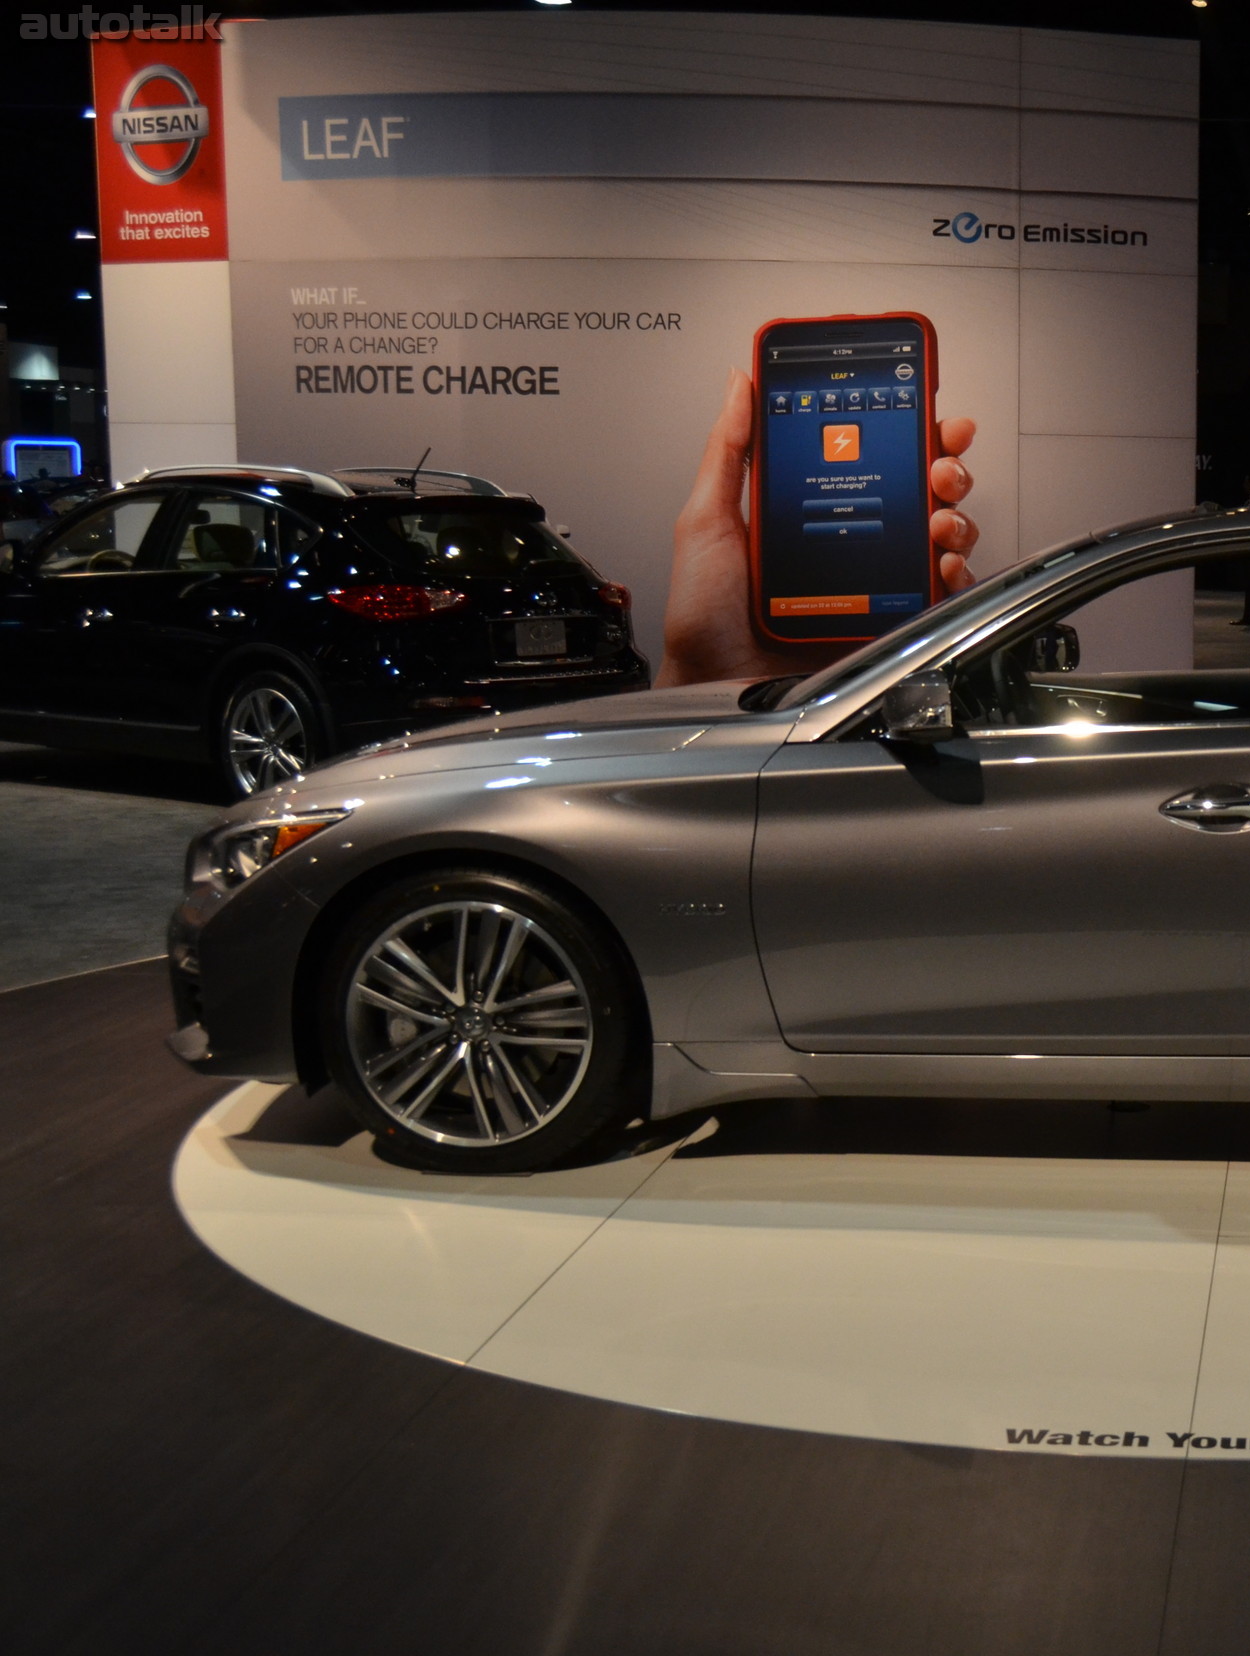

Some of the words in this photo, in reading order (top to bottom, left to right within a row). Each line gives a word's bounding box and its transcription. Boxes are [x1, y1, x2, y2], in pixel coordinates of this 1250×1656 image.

[122, 114, 200, 136] NISSAN
[302, 116, 405, 160] LEAF
[125, 209, 204, 226] Innovation
[119, 226, 151, 241] that
[153, 224, 211, 240] excites
[1023, 223, 1148, 246] Emission
[291, 288, 338, 305] WHAT
[292, 312, 338, 329] YOUR
[343, 312, 408, 329] PHONE
[412, 312, 478, 329] COULD
[483, 312, 569, 330] CHARGE
[574, 312, 631, 330] YOUR
[636, 312, 682, 330] CAR
[294, 337, 328, 354] FOR
[333, 337, 345, 354] A
[350, 337, 438, 354] CHANGE?
[295, 365, 415, 394] REMOTE
[422, 365, 560, 396] CHARGE
[830, 372, 849, 381] LEAF
[818, 476, 830, 484] you
[830, 475, 845, 483] sure
[845, 474, 857, 483] you
[858, 473, 873, 482] want
[820, 482, 835, 490] start
[836, 481, 867, 490] charging?
[1006, 1428, 1150, 1447] Watch
